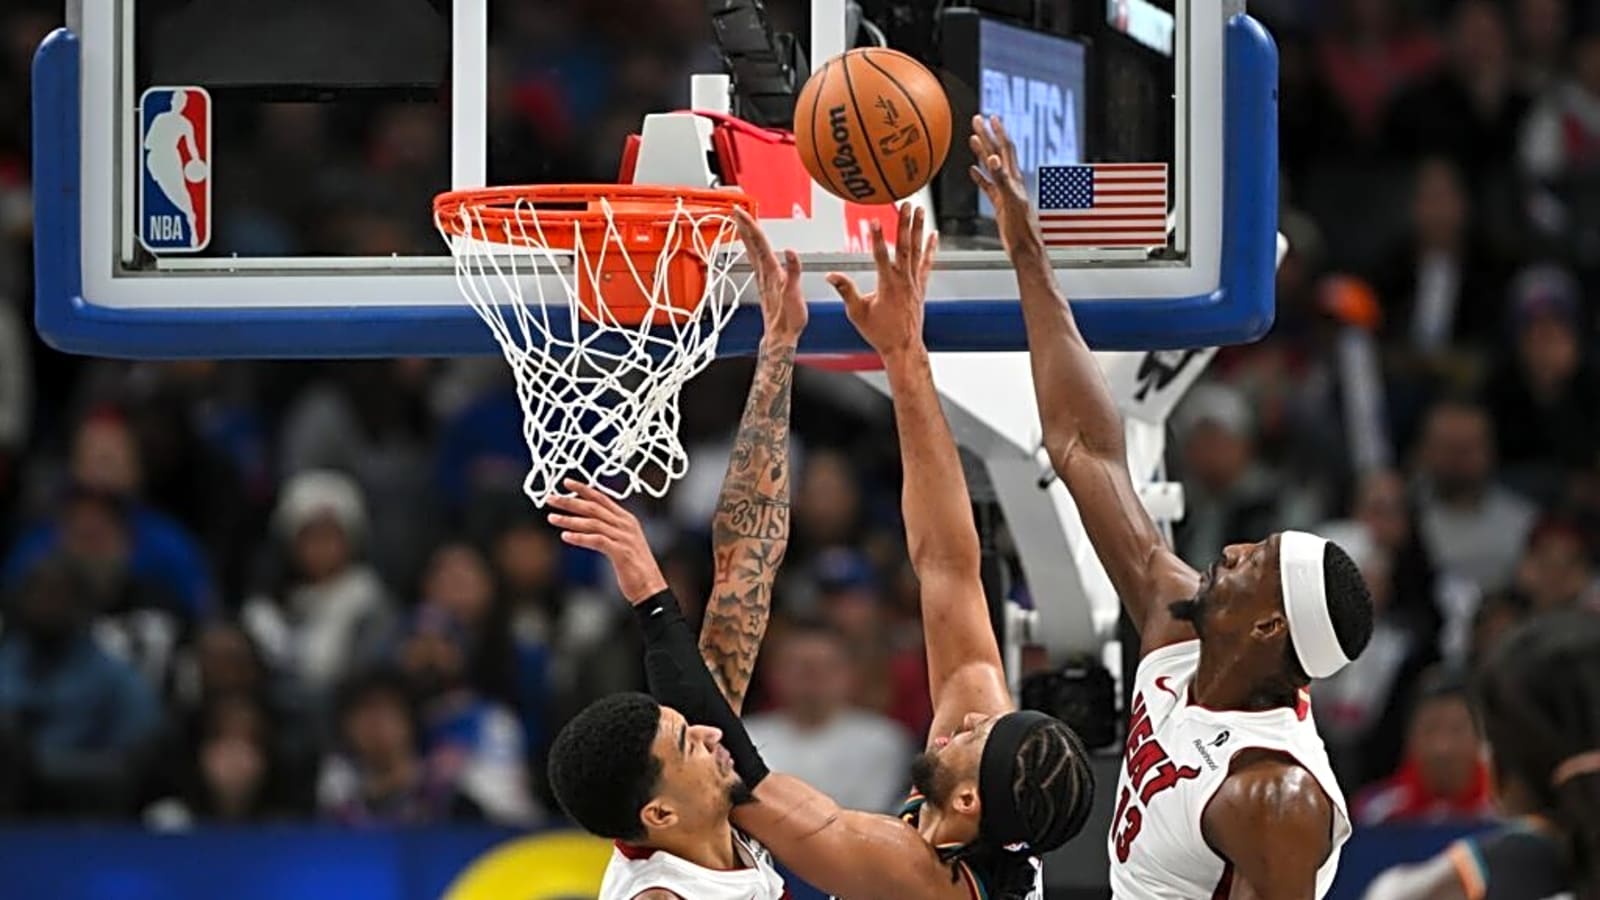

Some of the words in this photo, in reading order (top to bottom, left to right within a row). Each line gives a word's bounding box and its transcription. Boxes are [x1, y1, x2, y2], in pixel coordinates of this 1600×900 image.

[829, 103, 876, 199] Wilson
[150, 215, 183, 240] NBA
[1126, 691, 1202, 808] HEAT
[1112, 785, 1142, 863] 13
